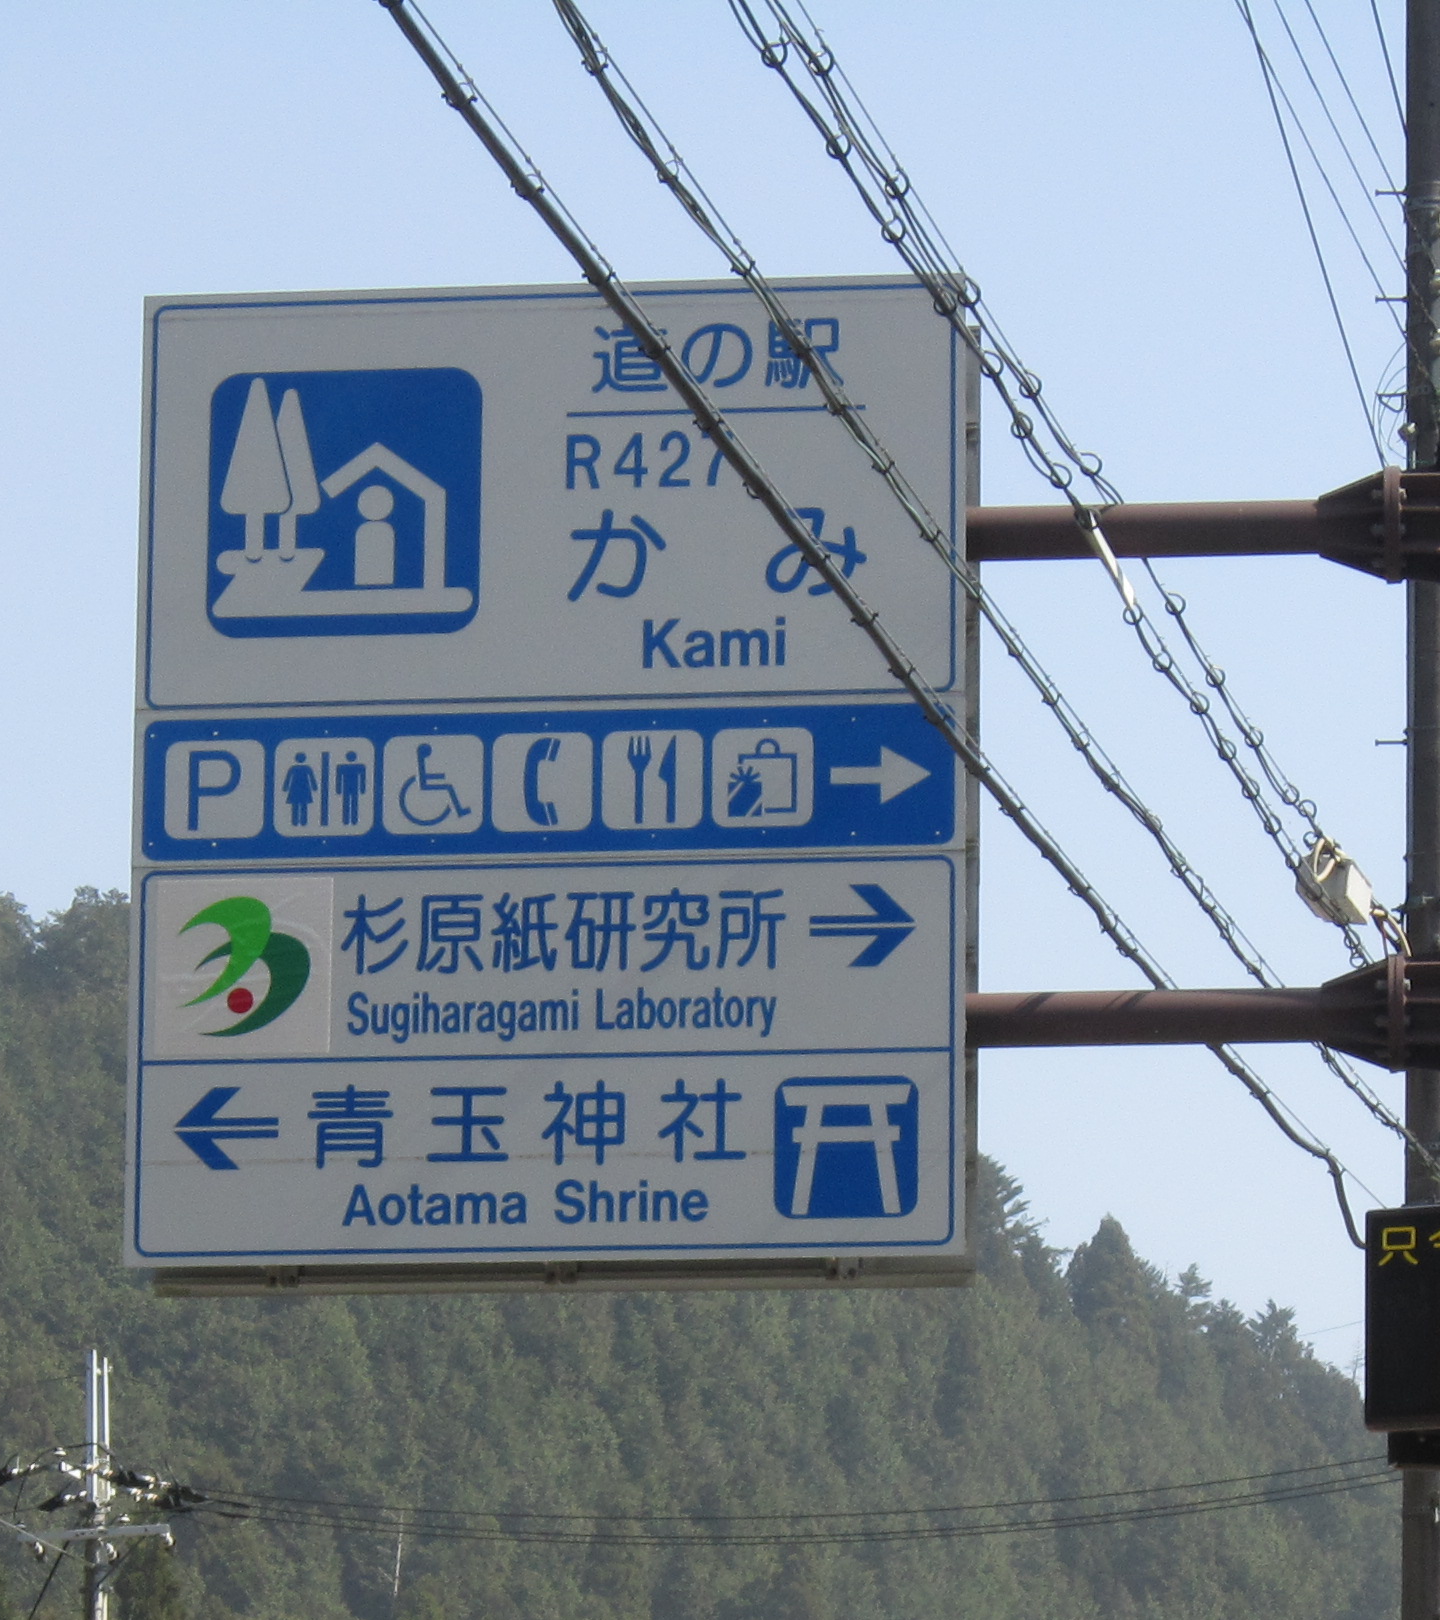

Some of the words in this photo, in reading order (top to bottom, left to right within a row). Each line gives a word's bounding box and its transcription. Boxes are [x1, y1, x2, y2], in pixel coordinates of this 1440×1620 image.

[591, 317, 845, 394] 道の駅
[567, 506, 869, 603] かみ
[642, 616, 787, 670] Kami
[186, 749, 243, 832] P
[340, 887, 789, 976] 杉原紙研究所
[347, 990, 581, 1045] Sugiharagami
[595, 987, 778, 1038] Laboratory
[306, 1077, 748, 1170] 青玉神社
[342, 1183, 529, 1228] Aotama
[554, 1178, 711, 1226] Shrine
